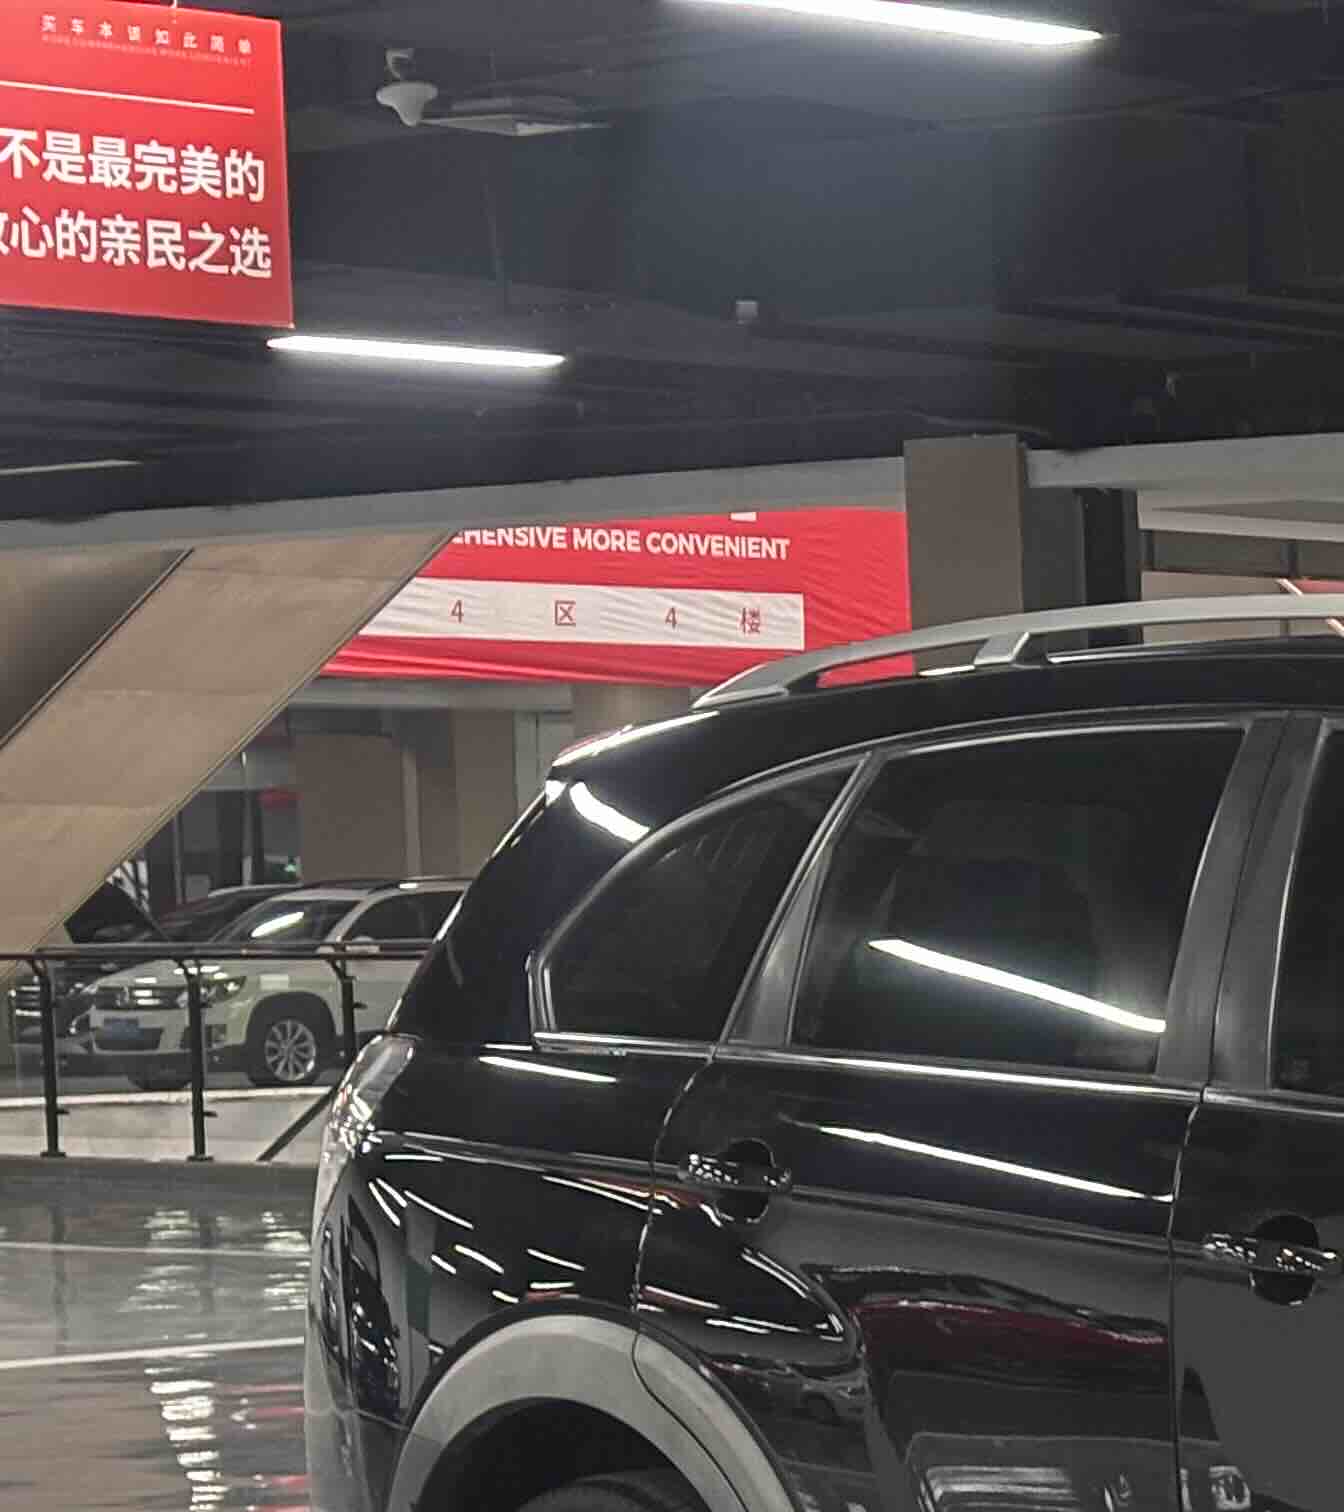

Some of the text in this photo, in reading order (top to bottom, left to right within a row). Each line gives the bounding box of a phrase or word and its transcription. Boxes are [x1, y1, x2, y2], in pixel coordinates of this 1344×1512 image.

[0, 127, 265, 203] 不是最完美的
[573, 528, 640, 553] MORE
[646, 532, 790, 561] CONVENIENT
